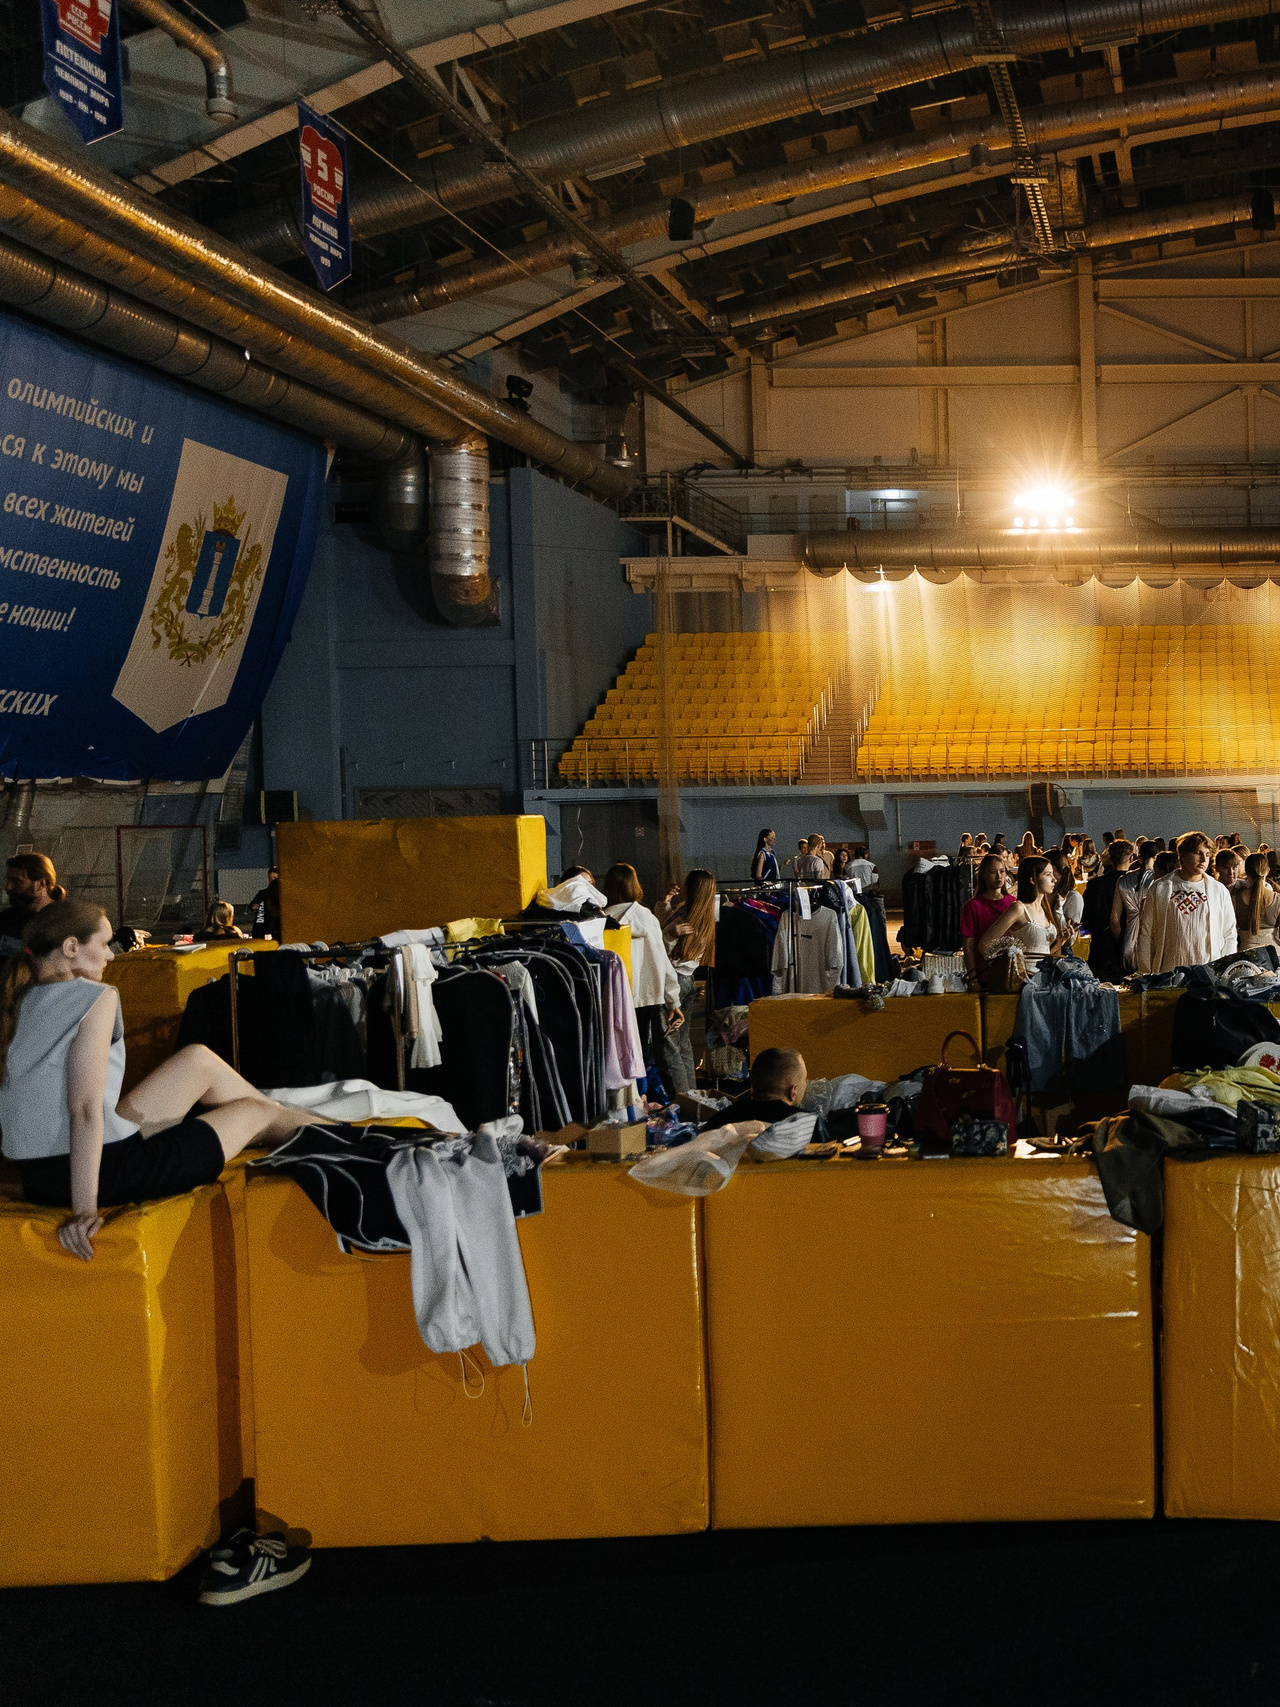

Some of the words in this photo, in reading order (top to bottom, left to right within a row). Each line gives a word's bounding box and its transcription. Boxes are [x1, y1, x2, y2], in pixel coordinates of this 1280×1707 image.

[317, 149, 329, 181] 5
[7, 378, 137, 439] олимпийских
[141, 425, 155, 445] и
[32, 443, 47, 464] к
[50, 449, 114, 490] этому
[116, 470, 145, 493] мы
[3, 492, 50, 521] всех
[50, 506, 136, 542] жителей
[8, 605, 76, 632] нации!
